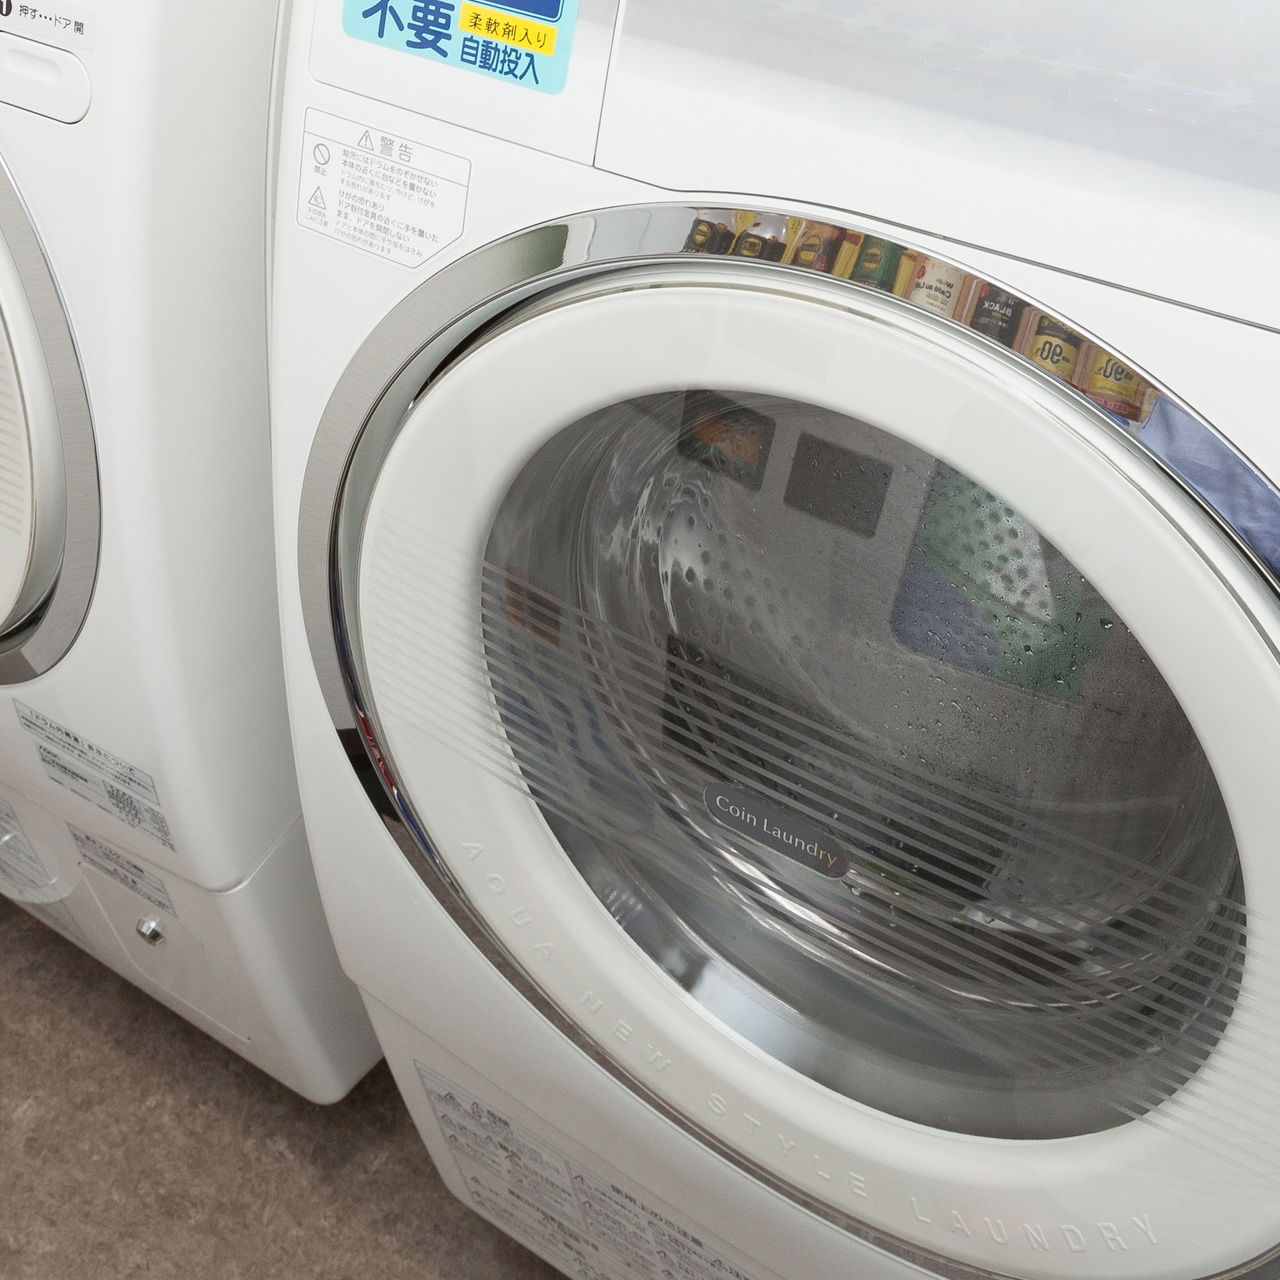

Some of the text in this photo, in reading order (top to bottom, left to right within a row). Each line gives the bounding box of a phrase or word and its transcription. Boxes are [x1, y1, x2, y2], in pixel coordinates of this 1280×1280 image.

[468, 12, 547, 49] 柔軟剤入り
[460, 36, 539, 85] 自動投入
[715, 795, 838, 868] Coin Laundry
